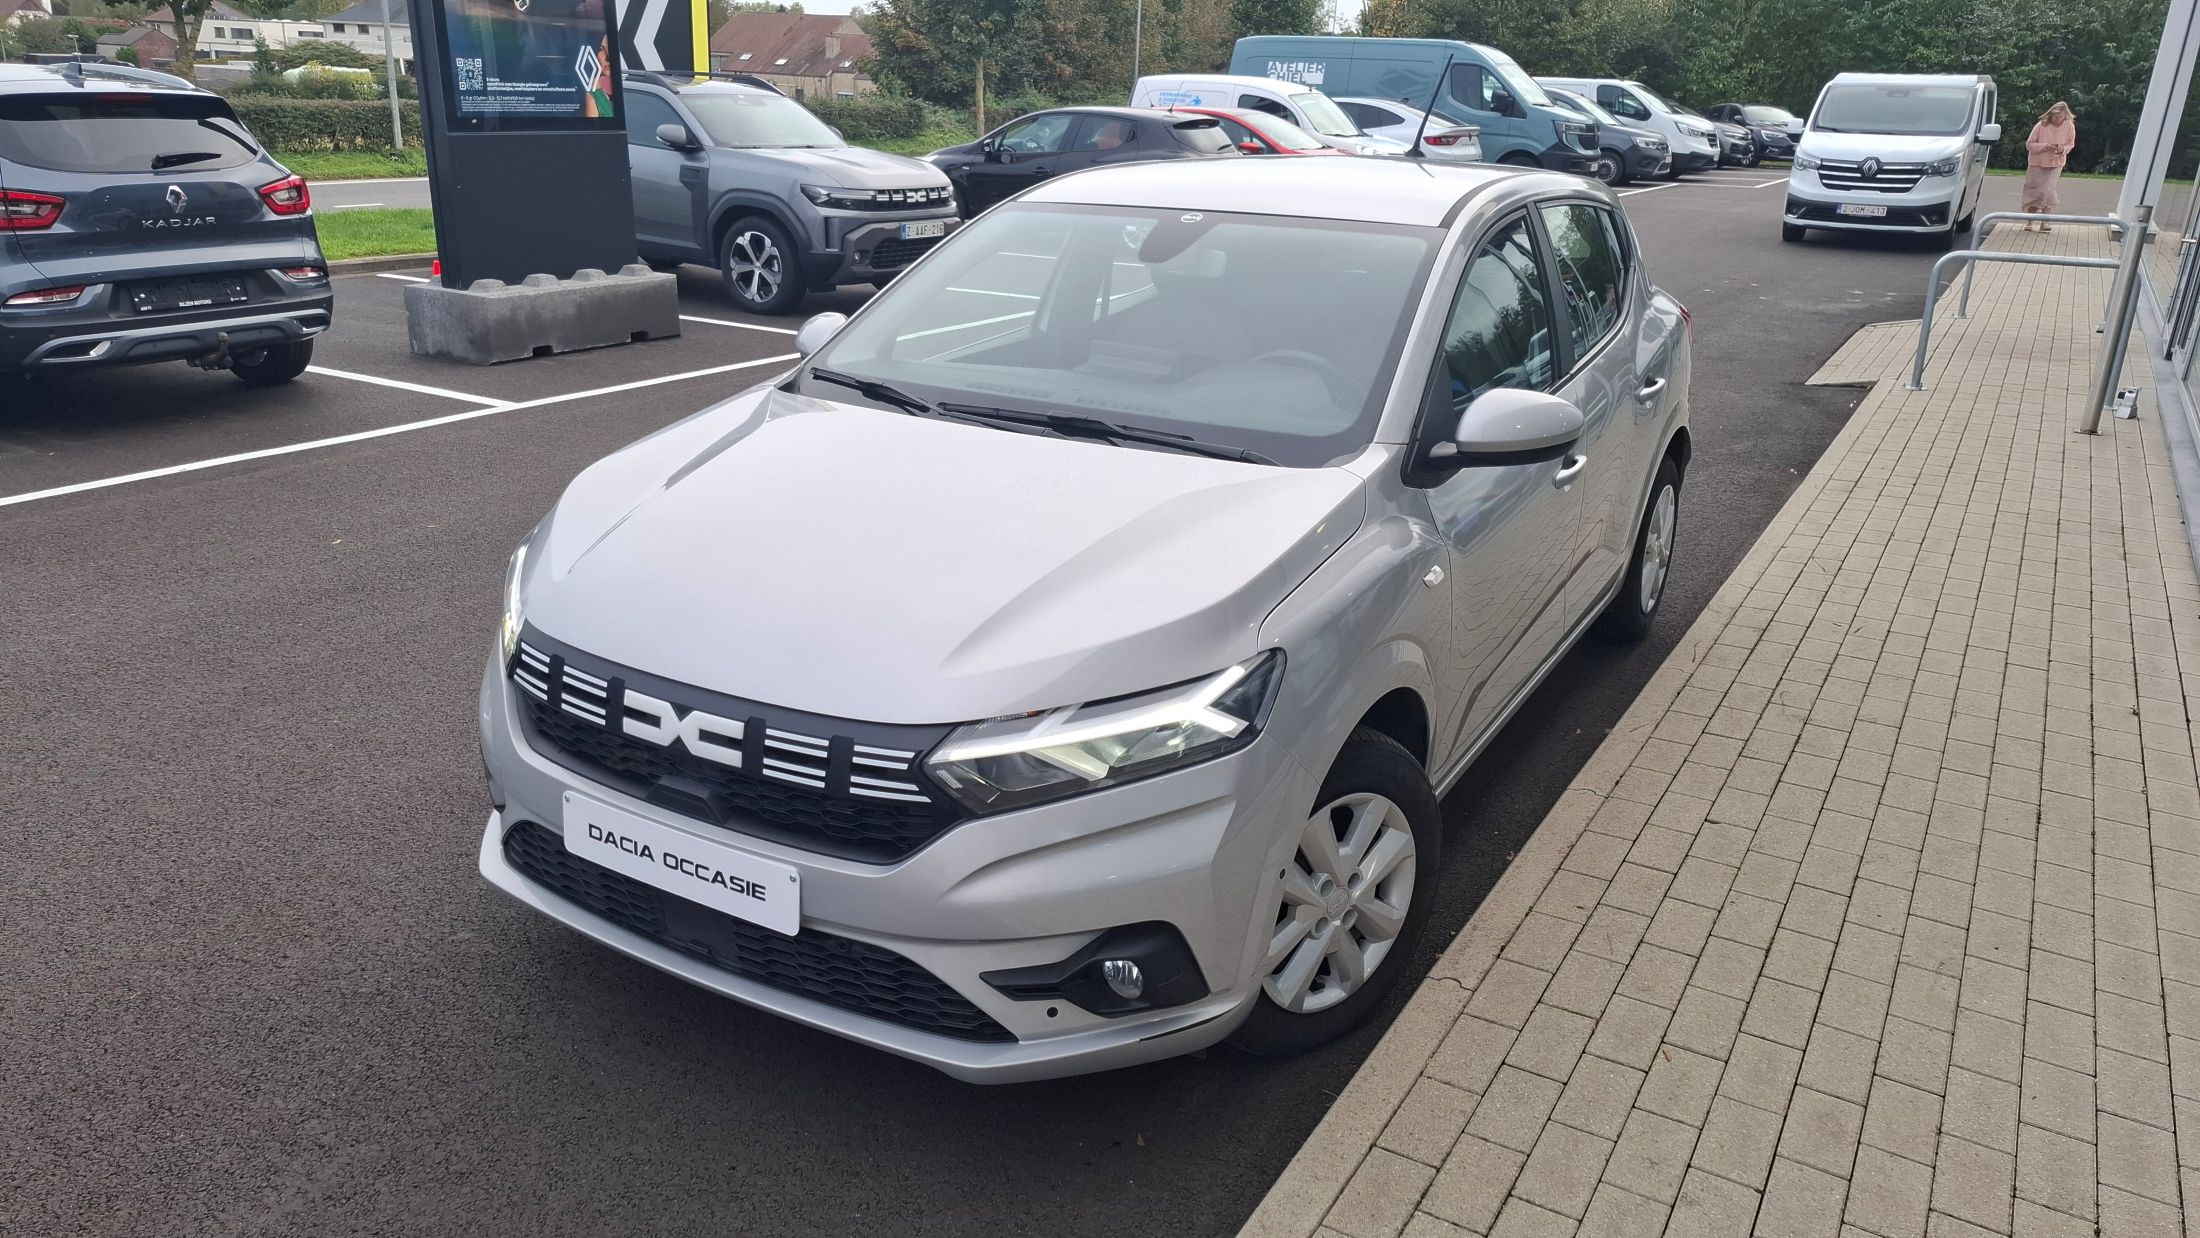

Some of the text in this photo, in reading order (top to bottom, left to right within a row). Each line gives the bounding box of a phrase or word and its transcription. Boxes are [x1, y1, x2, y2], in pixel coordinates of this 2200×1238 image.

[1268, 61, 1325, 74] ATELIER
[141, 216, 217, 229] KADJAR
[588, 822, 767, 902] DACIA OCCASIE
